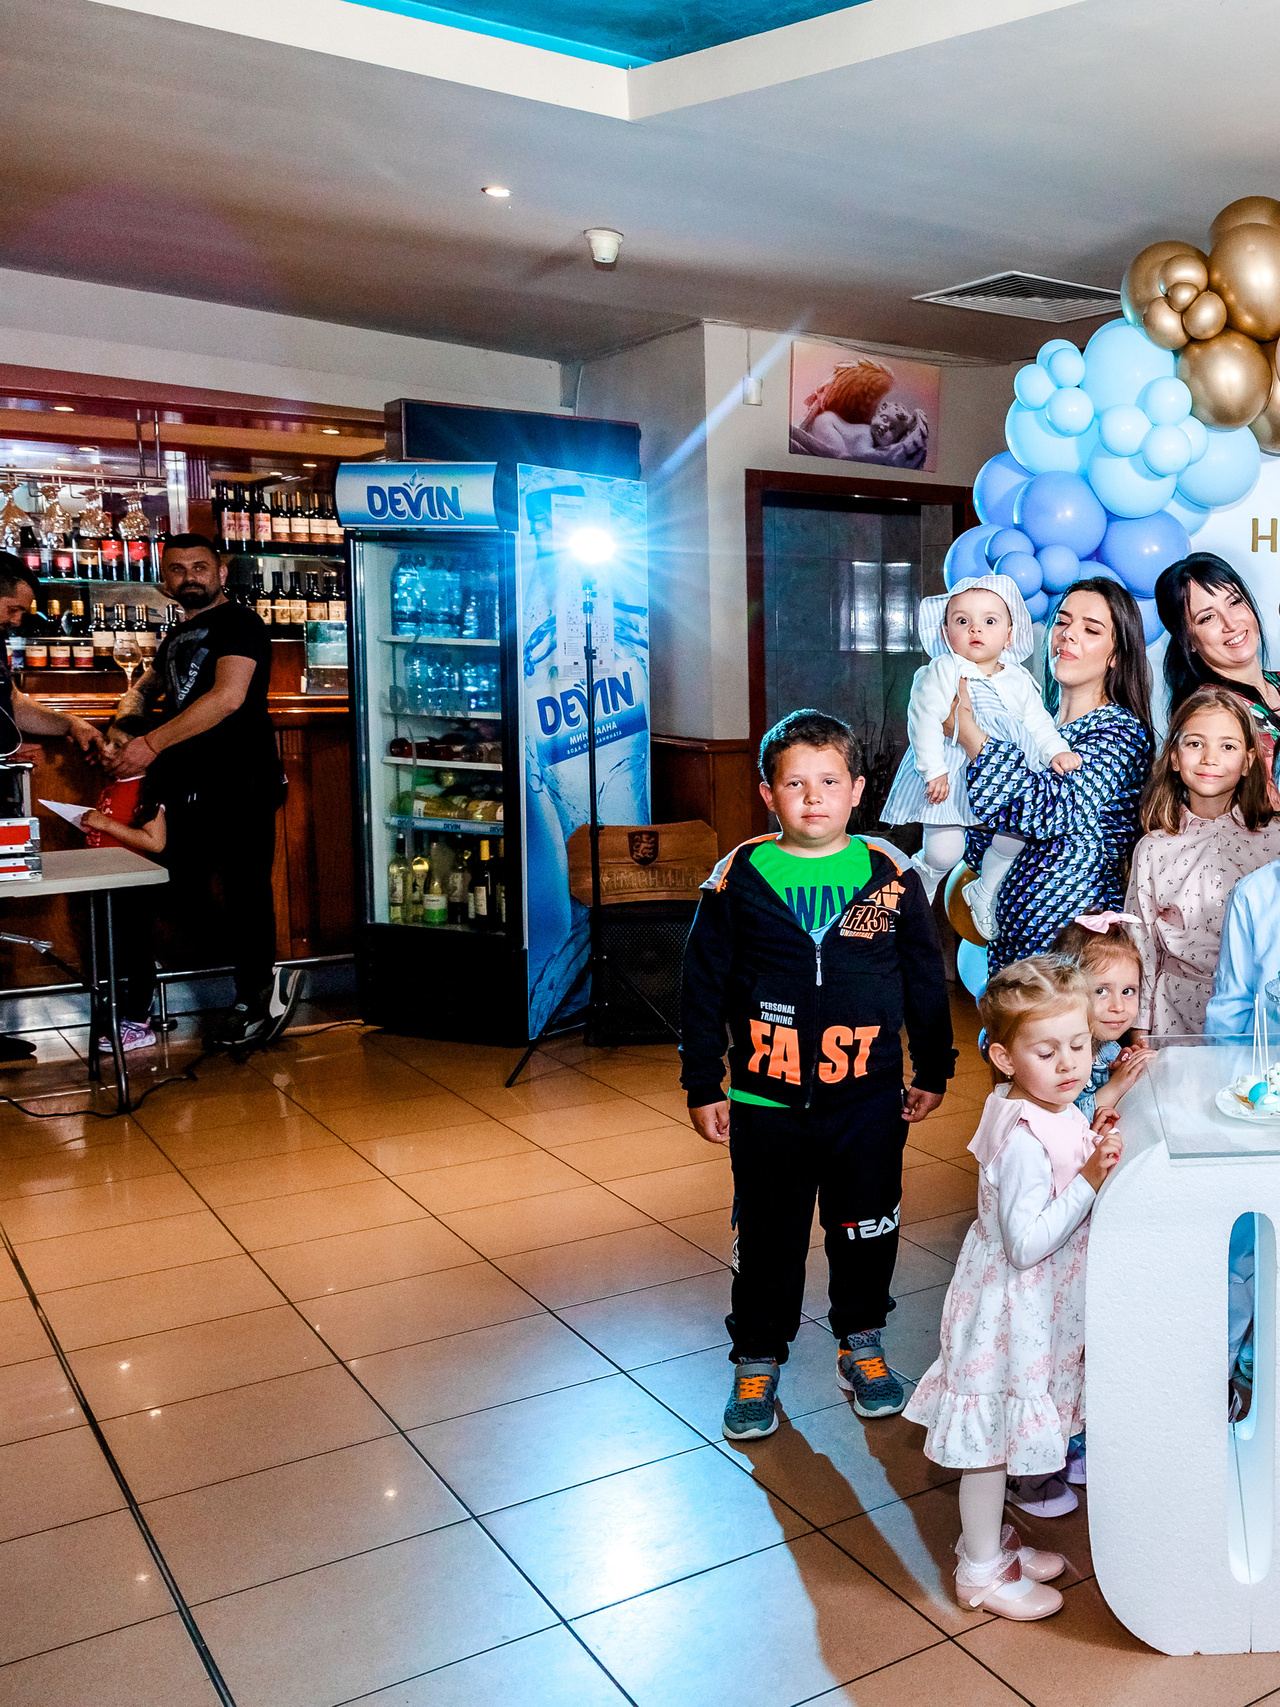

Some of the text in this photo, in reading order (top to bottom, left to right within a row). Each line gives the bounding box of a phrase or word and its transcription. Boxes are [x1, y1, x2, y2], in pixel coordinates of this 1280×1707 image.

[366, 485, 464, 520] DEVIN
[536, 671, 635, 736] DEVIN
[569, 721, 618, 745] МИНАЛНА
[760, 1001, 796, 1015] PERSONAL
[760, 1011, 793, 1026] TRAINING
[748, 1019, 881, 1085] FAST
